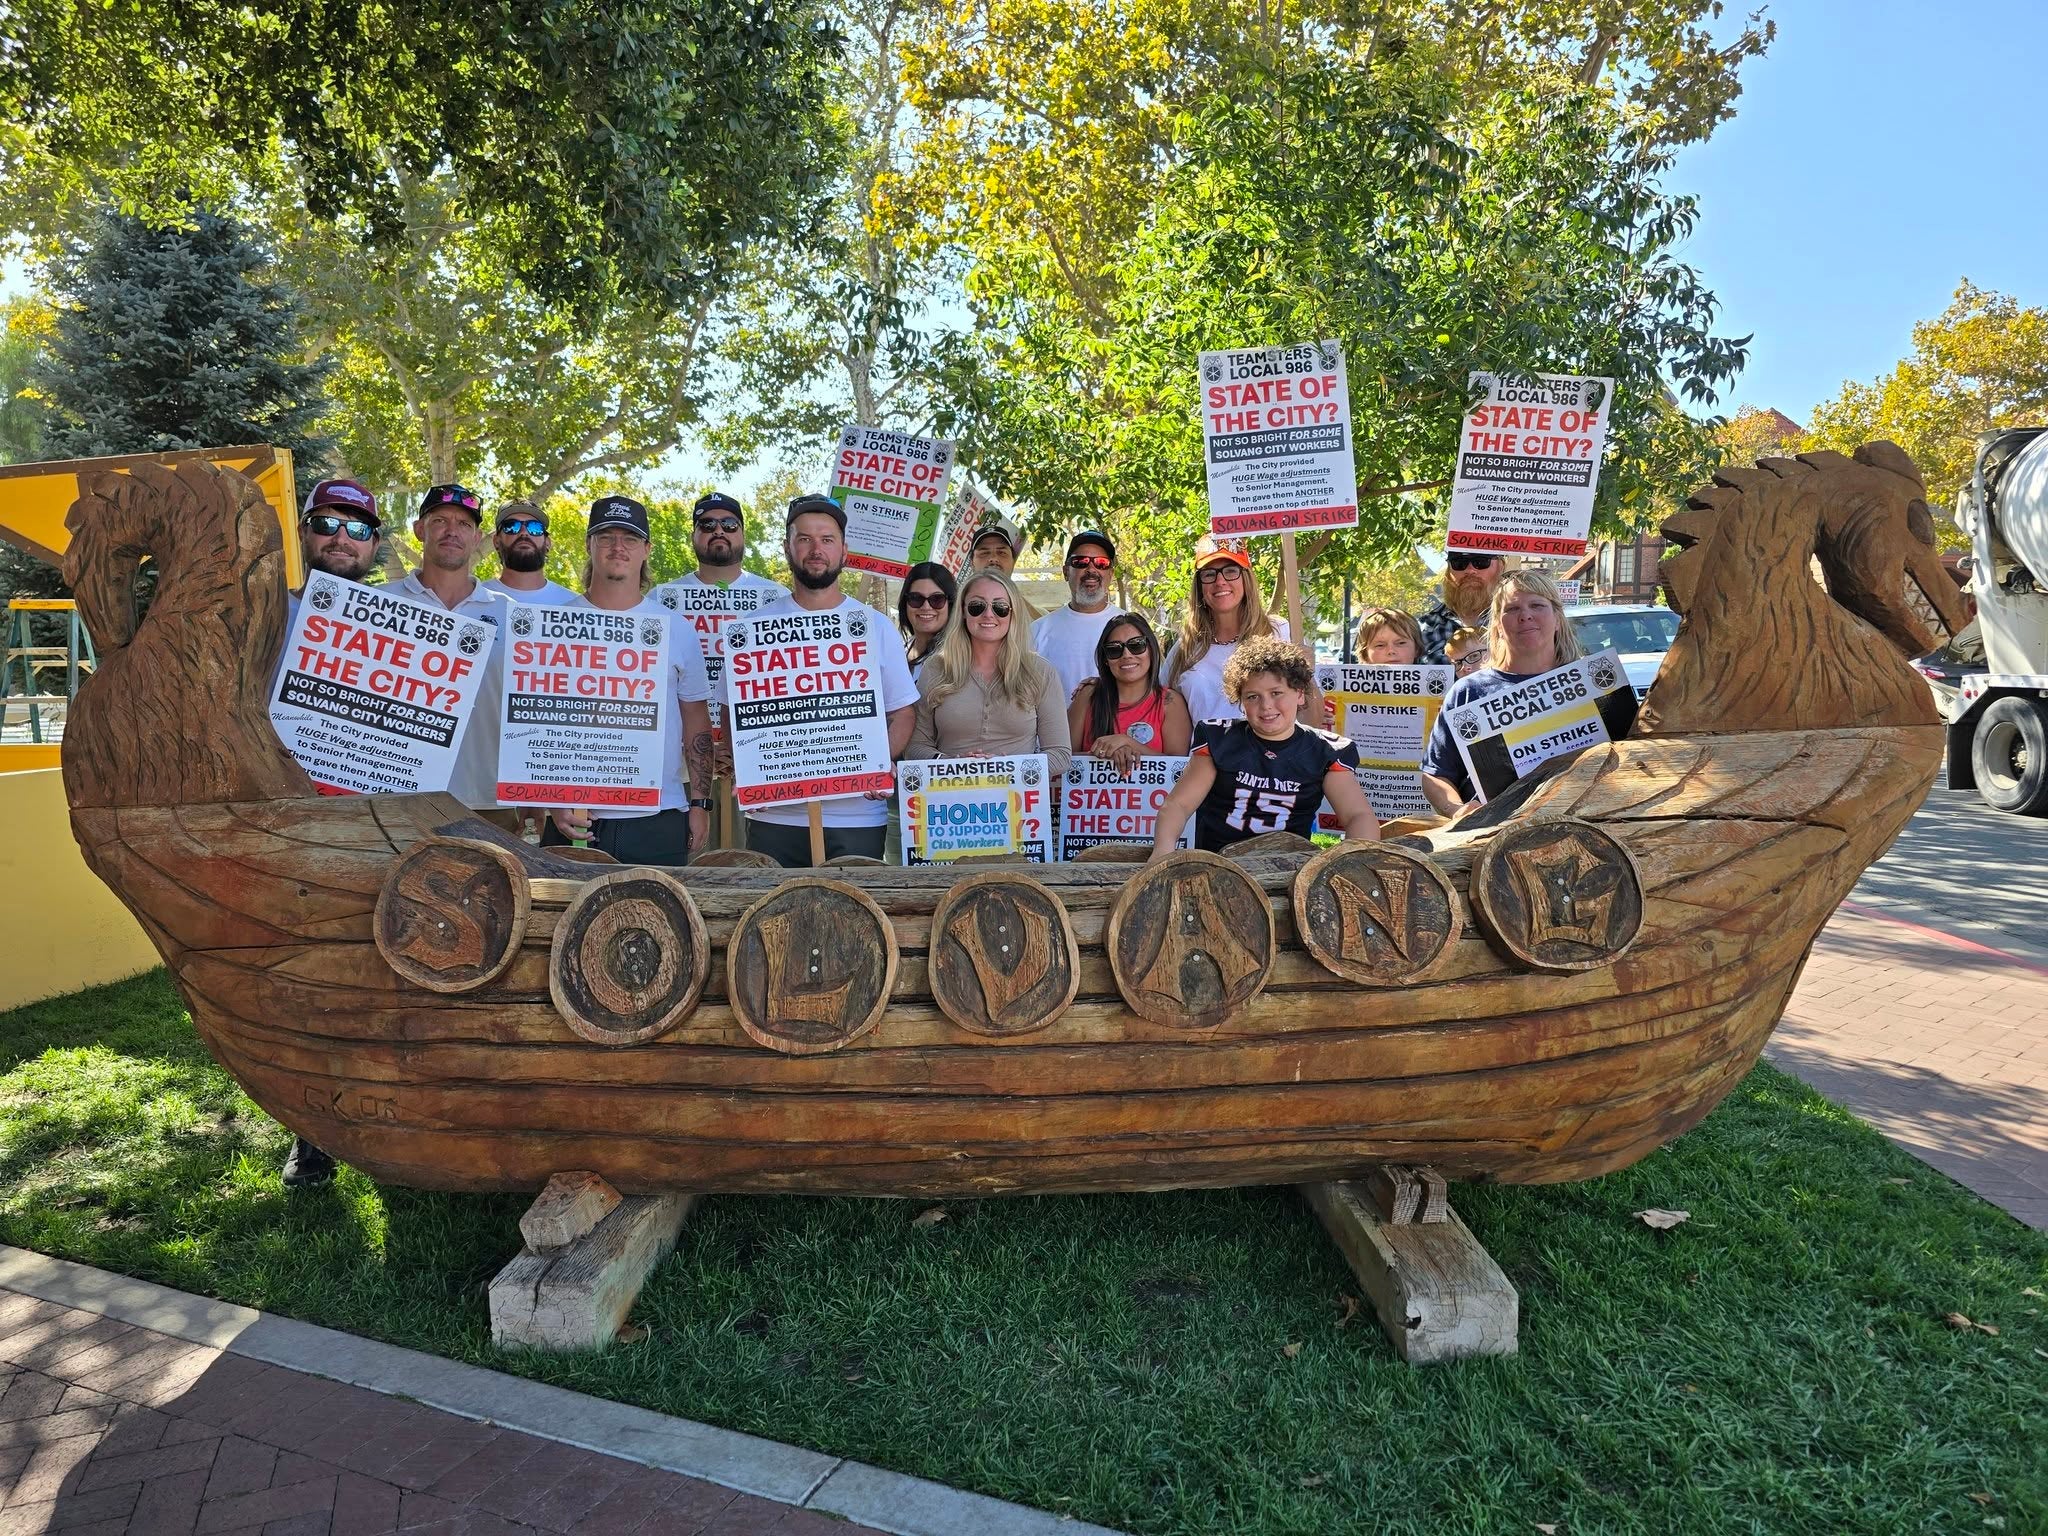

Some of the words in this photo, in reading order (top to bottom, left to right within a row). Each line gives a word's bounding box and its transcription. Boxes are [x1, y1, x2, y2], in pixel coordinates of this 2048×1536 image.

[1228, 347, 1312, 366] TEAMSTERS
[1230, 363, 1282, 379] LOCAL
[1285, 360, 1312, 374] 986
[1209, 379, 1291, 408] STATE
[1299, 375, 1336, 399] OF
[1497, 389, 1547, 403] LOCAL
[1551, 393, 1578, 406] 986
[1210, 410, 1260, 433] THE
[1267, 403, 1338, 427] CITY?
[1472, 405, 1552, 430] STATE
[1560, 411, 1598, 433] OF
[865, 431, 931, 450] TEAMSTERS
[1212, 437, 1233, 448] NOT
[1234, 436, 1249, 445] SO
[1251, 431, 1287, 443] BRIGHT
[1289, 430, 1310, 440] FOR
[1312, 427, 1341, 438] SOME
[1469, 432, 1516, 452] THE
[1522, 435, 1592, 458] CITY?
[863, 440, 903, 456] LOCAL
[906, 448, 928, 460] 986
[1215, 446, 1262, 459] SOLVANG
[1264, 443, 1287, 454] CITY
[1288, 439, 1339, 451] WORKERS
[841, 451, 907, 476] STATE
[912, 464, 944, 483] OF
[1465, 456, 1486, 465] NOT
[1486, 457, 1501, 466] SO
[1502, 458, 1538, 468] BRIGHT
[1539, 460, 1560, 470] FOR
[1560, 462, 1590, 473] SOME
[1465, 468, 1511, 478] SOLVANG
[1513, 470, 1535, 479] CITY
[1536, 472, 1585, 483] WORKERS
[838, 470, 876, 490] THE
[881, 478, 938, 503] CITY?
[854, 502, 868, 511] ON
[872, 504, 910, 520] STRIKE
[964, 497, 979, 525] OF
[683, 589, 757, 599] TEAMSTERS
[348, 588, 454, 631] TEAMSTERS
[685, 600, 730, 610] LOCAL
[734, 601, 757, 610] 986
[342, 603, 408, 634] LOCAL
[414, 625, 449, 646] 986
[541, 610, 634, 629] TEAMSTERS
[752, 614, 840, 632] TEAMSTERS
[541, 624, 599, 640] LOCAL
[603, 629, 633, 643] 986
[755, 629, 809, 645] LOCAL
[812, 626, 841, 640] 986
[303, 616, 413, 667] STATE
[421, 651, 472, 682] OF
[514, 641, 606, 668] STATE
[616, 648, 657, 672] OF
[733, 646, 819, 674] STATE
[827, 641, 866, 665] OF
[298, 647, 362, 684] THE
[369, 669, 460, 711] CITY?
[512, 670, 568, 693] THE
[576, 674, 655, 699] CITY?
[735, 676, 788, 700] THE
[794, 669, 868, 693] CITY?
[1341, 669, 1420, 681] TEAMSTERS
[1344, 682, 1390, 693] LOCAL
[1393, 683, 1420, 694] 986
[1480, 668, 1582, 715] TEAMSTERS
[288, 675, 317, 690] NOT
[317, 684, 336, 696] SO
[339, 689, 387, 709] BRIGHT
[387, 703, 415, 719] FOR
[416, 712, 454, 730] SOME
[511, 697, 535, 707] NOT
[537, 698, 553, 708] SO
[555, 699, 597, 710] BRIGHT
[598, 702, 621, 713] FOR
[623, 704, 655, 715] SOME
[737, 704, 759, 714] NOT
[761, 702, 776, 712] SO
[778, 698, 816, 710] BRIGHT
[818, 696, 840, 706] FOR
[842, 693, 872, 704] SOME
[1351, 705, 1367, 713] ON
[1371, 706, 1417, 715] STRIKE
[1488, 699, 1552, 730] LOCAL
[1552, 683, 1587, 706] 986
[286, 690, 349, 714] SOLVANG
[351, 707, 381, 723] CITY
[383, 716, 446, 741] WORKERS
[513, 710, 567, 721] SOLVANG
[569, 713, 595, 723] CITY
[596, 714, 652, 726] WORKERS
[741, 713, 790, 726] SOLVANG
[792, 710, 816, 720] CITY
[818, 705, 871, 717] WORKERS
[808, 723, 845, 734] provided
[758, 740, 783, 750] HUGE
[785, 739, 808, 749] Wage
[810, 733, 862, 746] adjustments
[1512, 744, 1535, 759] ON
[1539, 722, 1599, 750] STRIKE
[773, 750, 801, 759] Senior
[802, 744, 860, 755] Management.
[780, 761, 800, 770] gave
[825, 753, 867, 764] ANOTHER
[765, 772, 802, 781] Increase
[839, 764, 862, 772] that!
[928, 761, 1015, 776] TEAMSTERS
[1090, 773, 1136, 784] LOCAL
[1139, 773, 1165, 784] 986
[1364, 773, 1379, 781] City
[744, 786, 804, 802] SOLVANG
[811, 781, 828, 794] ON
[833, 774, 886, 792] STRIKE
[1236, 771, 1269, 788] SANTA
[1274, 778, 1301, 792] YNEZ
[1068, 789, 1142, 810] STATE
[928, 802, 1008, 825] HONK
[1226, 788, 1296, 833] 15
[928, 827, 945, 837] TO
[950, 824, 1008, 836] SUPPORT
[1067, 815, 1110, 833] THE
[931, 840, 953, 850] City
[957, 838, 1004, 848] Workers
